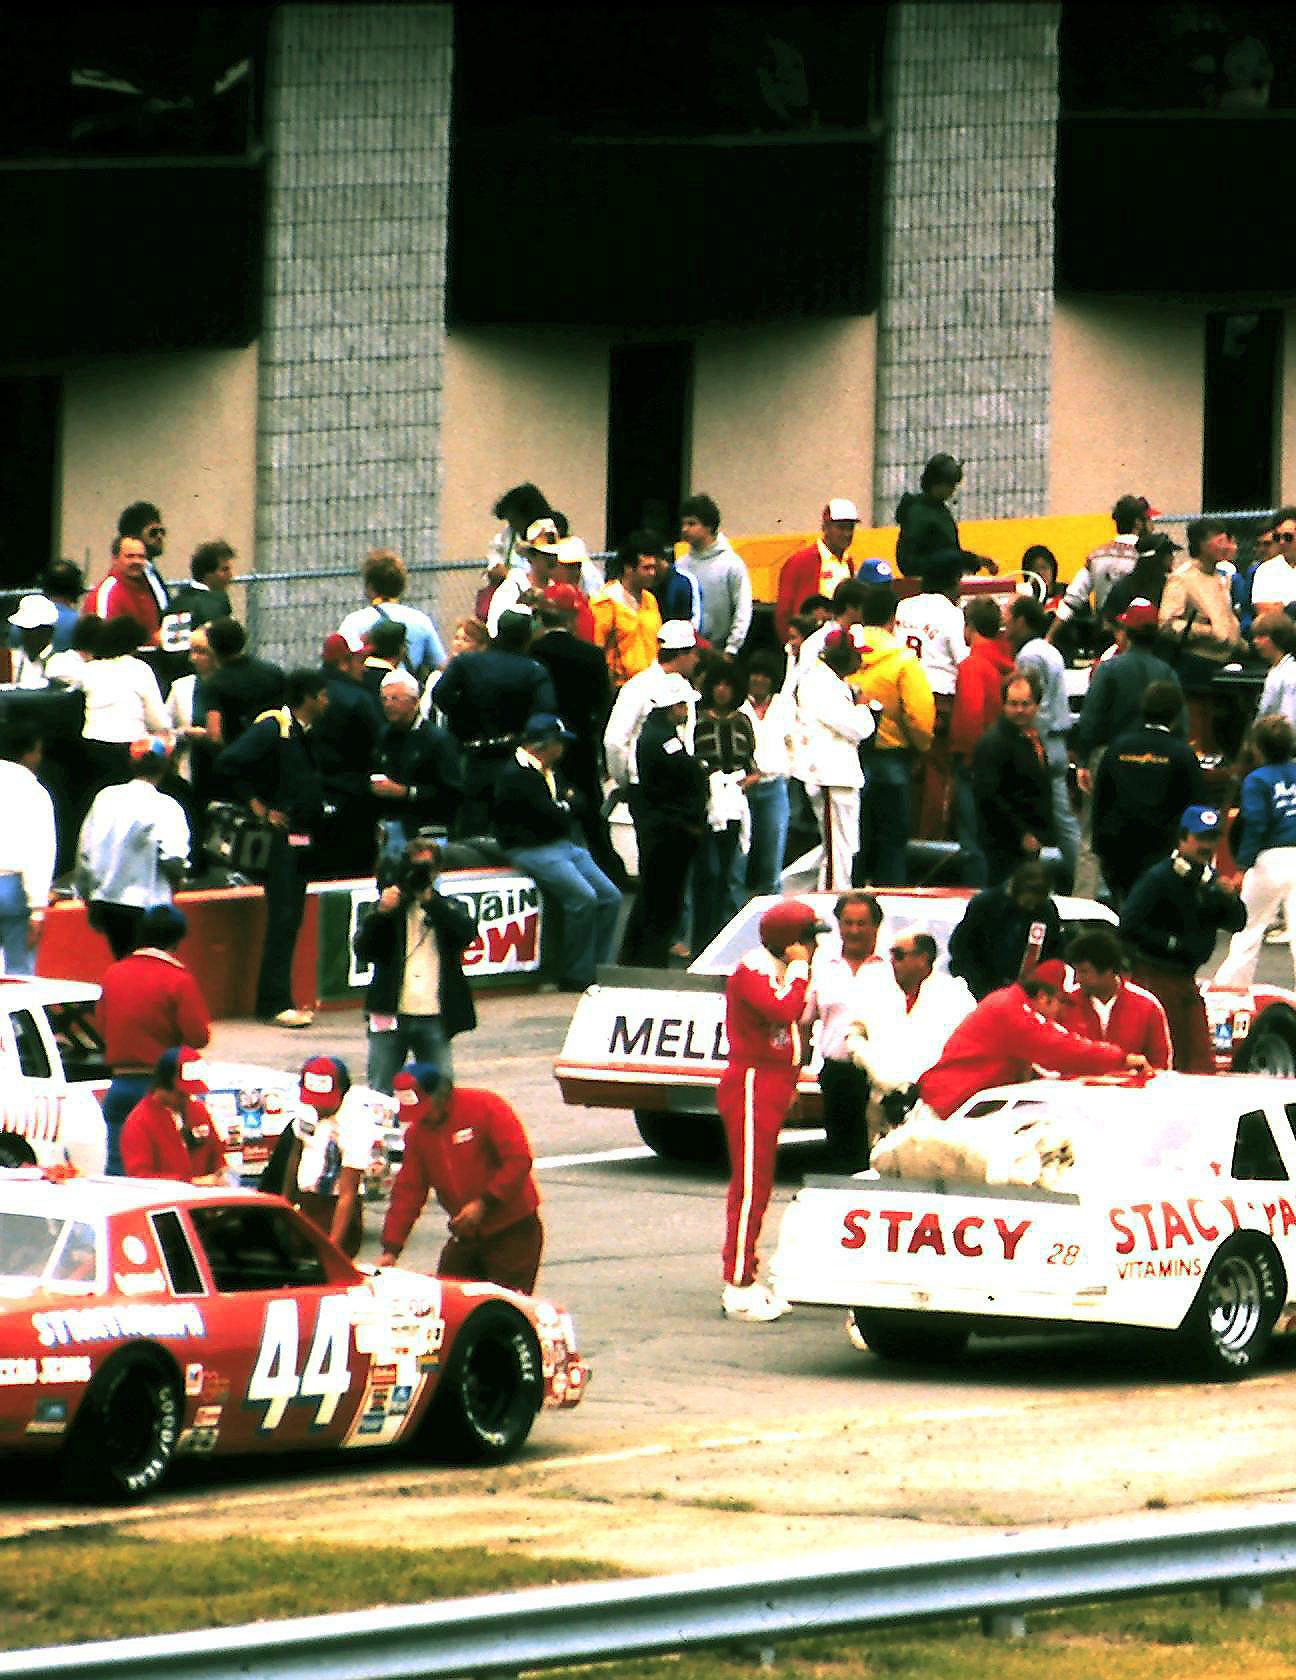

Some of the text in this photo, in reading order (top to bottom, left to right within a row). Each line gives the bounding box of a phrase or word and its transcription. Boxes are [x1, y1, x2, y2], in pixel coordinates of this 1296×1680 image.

[840, 1209, 1033, 1261] STACY
[1046, 1243, 1081, 1266] 28
[1115, 1257, 1202, 1279] VITAMINS
[247, 1293, 353, 1431] 44
